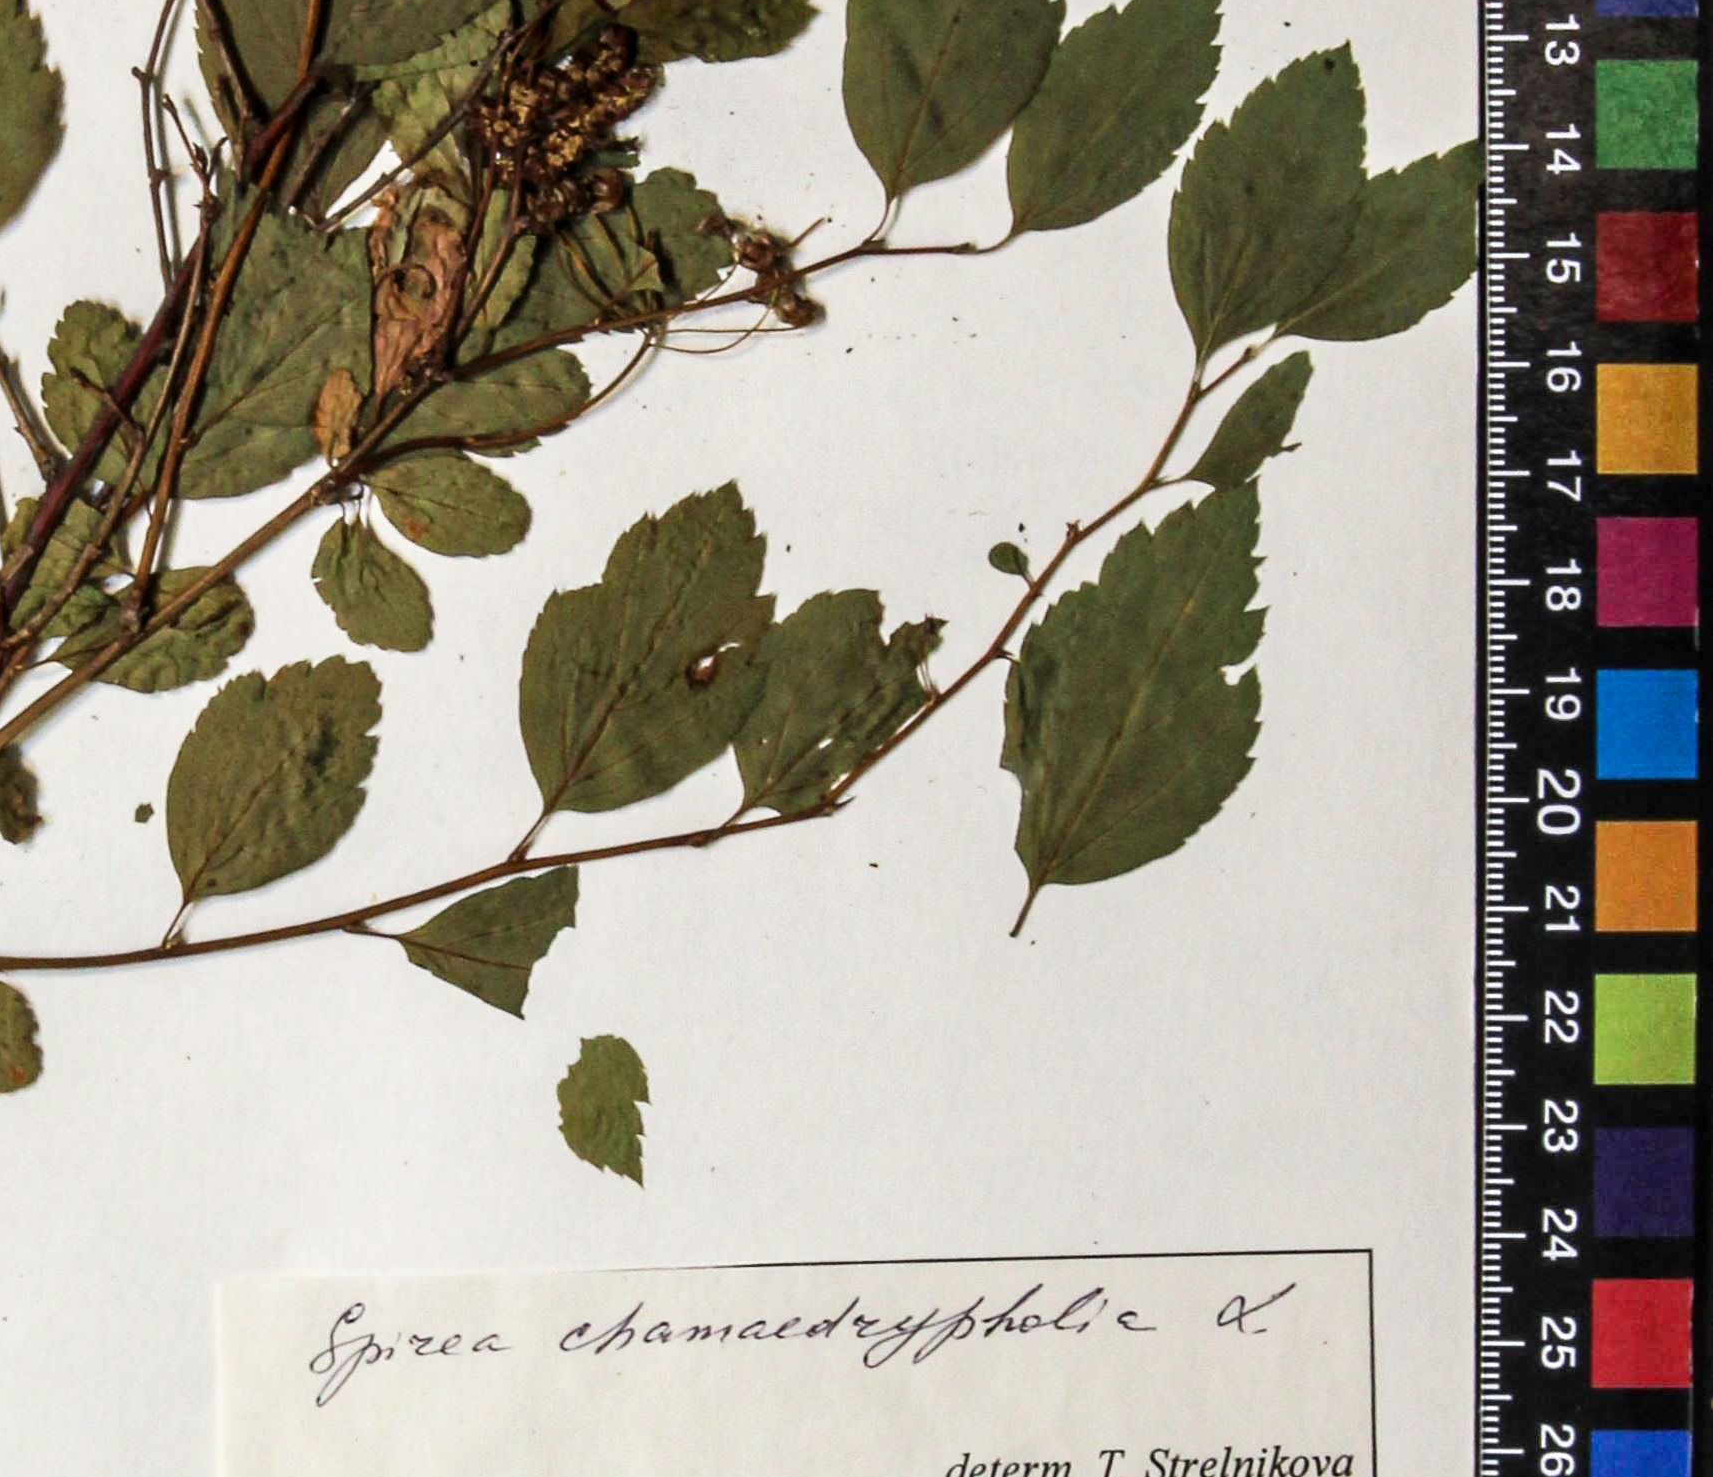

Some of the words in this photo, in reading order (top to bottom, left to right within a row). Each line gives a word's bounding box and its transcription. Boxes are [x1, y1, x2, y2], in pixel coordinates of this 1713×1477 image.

[1544, 13, 1581, 66] 13
[1545, 123, 1582, 176] 14
[1545, 231, 1582, 284] 15
[1545, 340, 1583, 393] 16
[1546, 449, 1583, 503] 17
[1544, 558, 1583, 612] 18
[1544, 666, 1583, 722] 19
[1536, 767, 1582, 836] 20
[1544, 884, 1581, 932] 21
[1543, 989, 1580, 1045] 22
[1542, 1098, 1580, 1154] 23
[1541, 1207, 1579, 1262] 24
[1540, 1315, 1577, 1370] 25
[1539, 1423, 1576, 1477] 26
